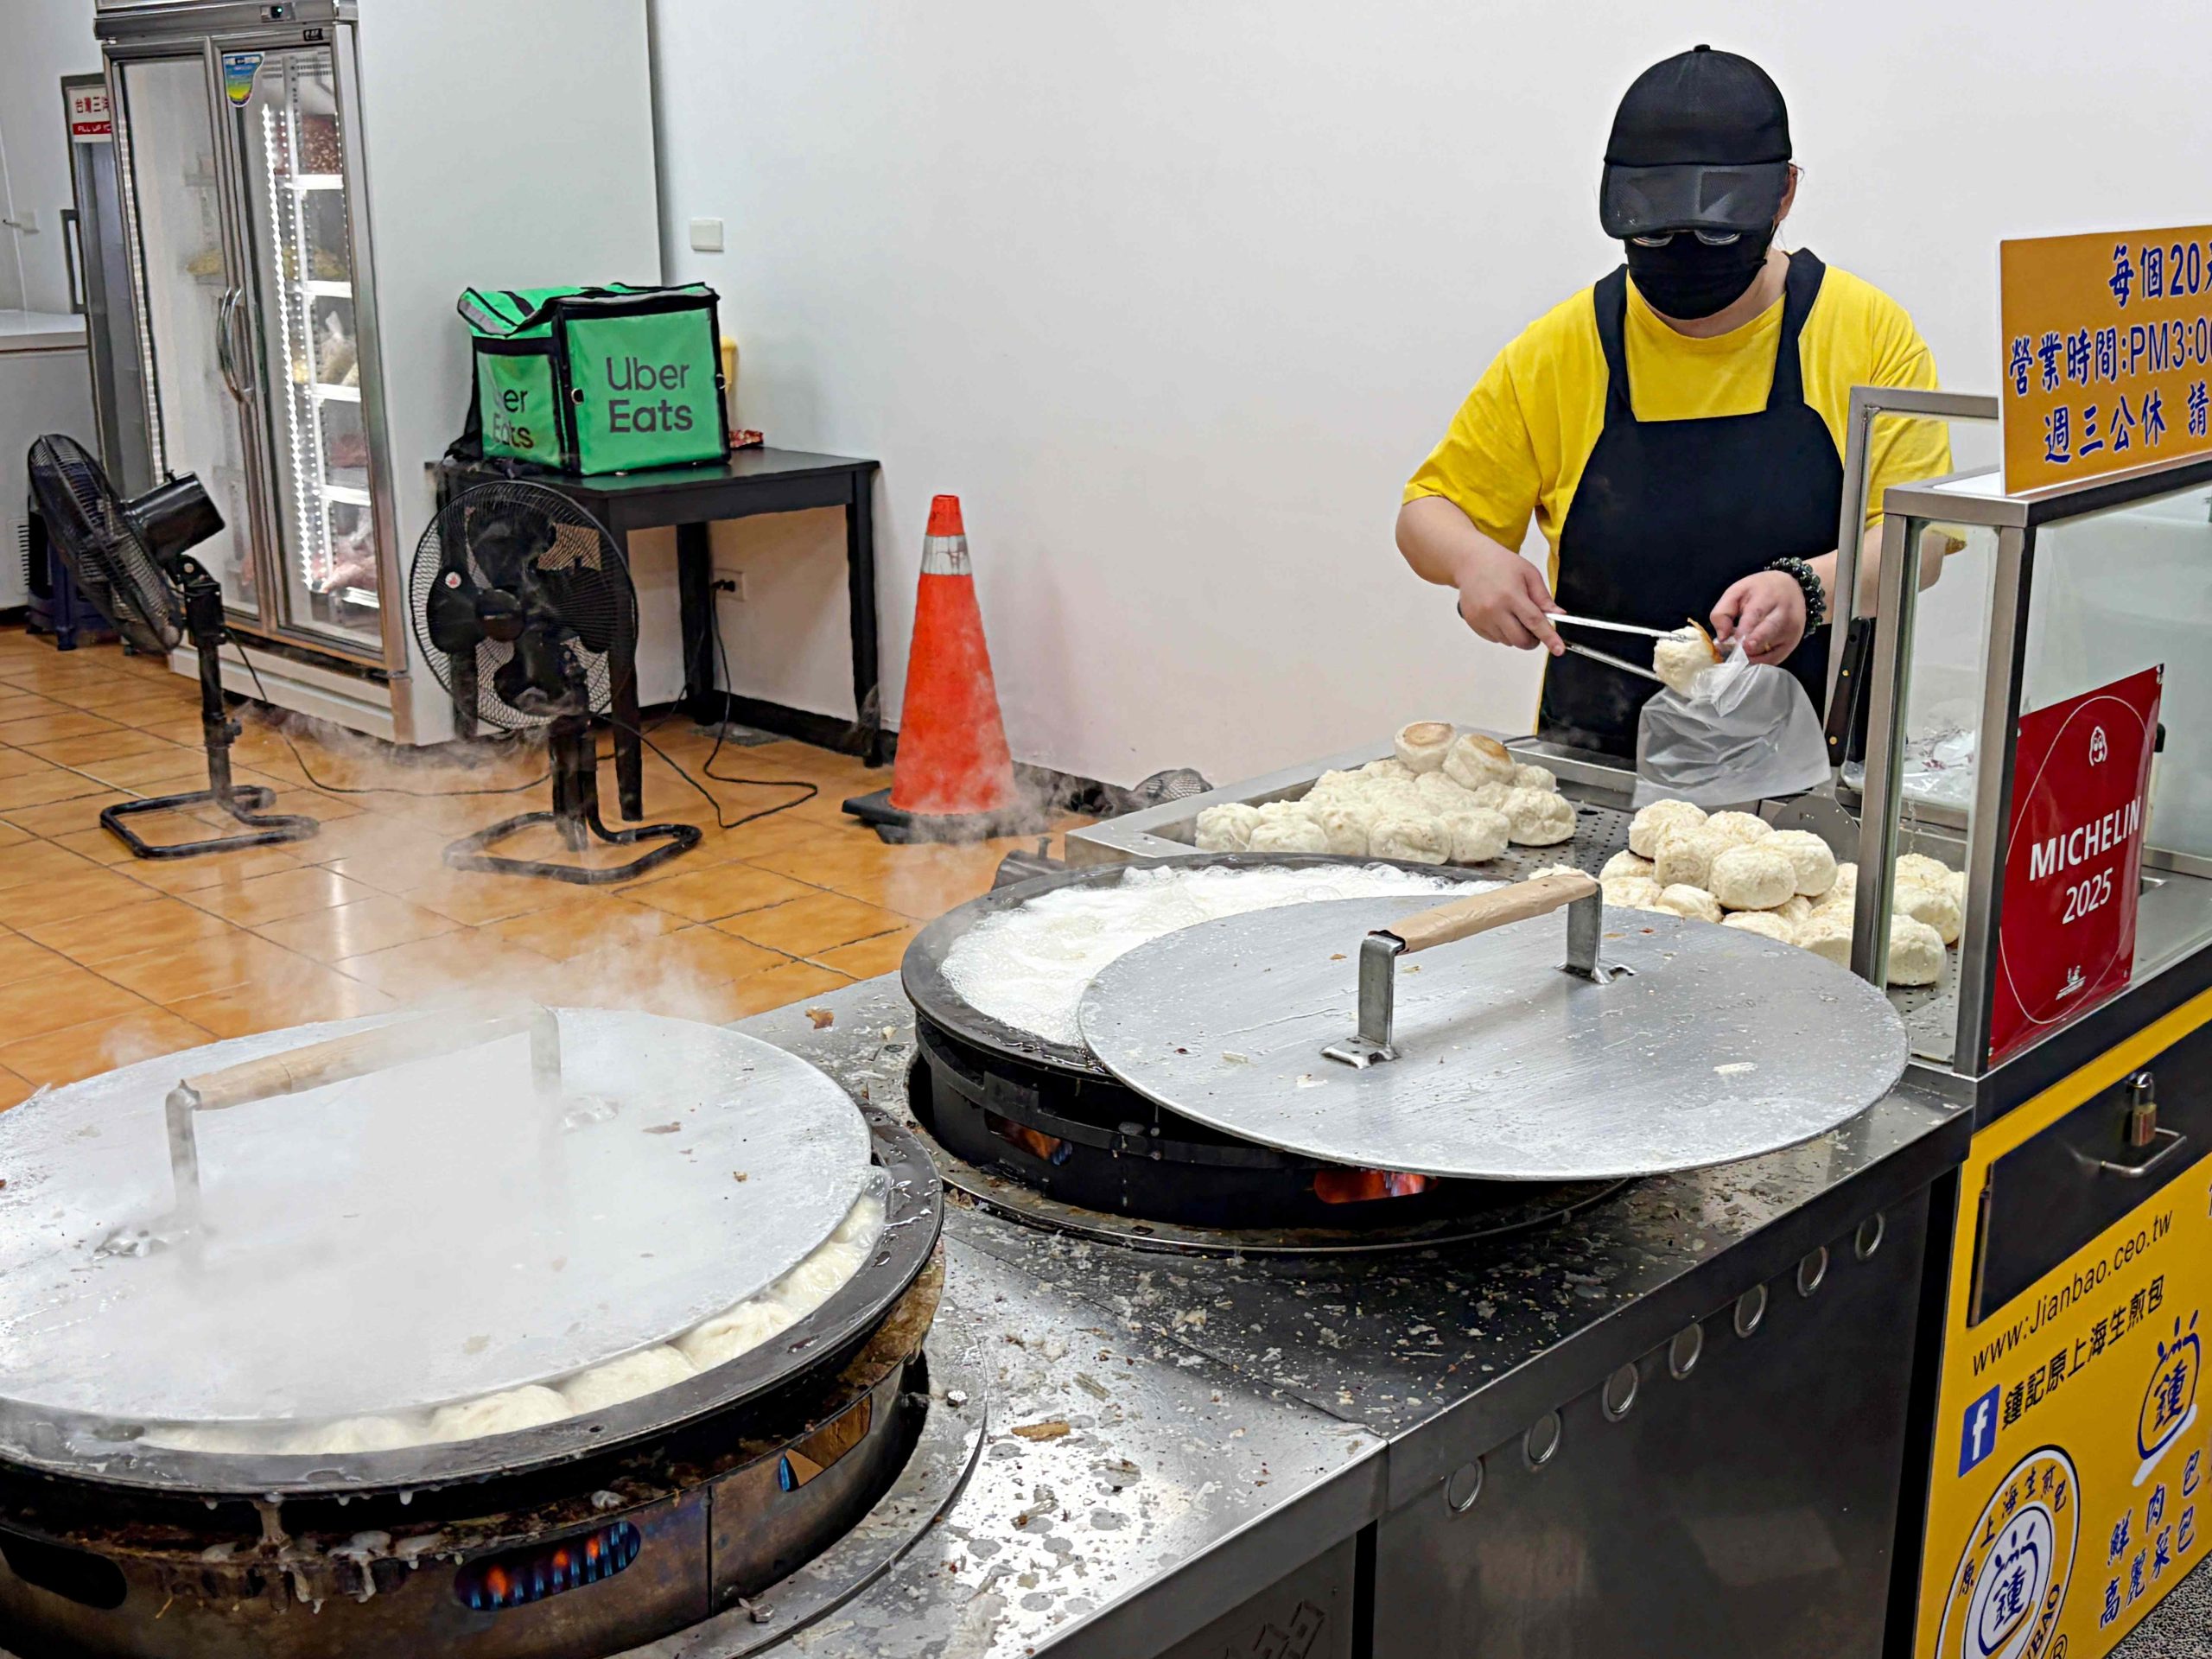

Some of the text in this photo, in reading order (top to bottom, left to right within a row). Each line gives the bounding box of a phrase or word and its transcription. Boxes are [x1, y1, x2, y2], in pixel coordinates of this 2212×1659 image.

[606, 357, 690, 390] Uber
[2009, 317, 2212, 396] 營業時間:PM3:0
[608, 398, 693, 433] Eats
[2044, 390, 2166, 463] 週三公休
[2029, 795, 2141, 881] MICHELIN
[2062, 868, 2113, 925] 2025
